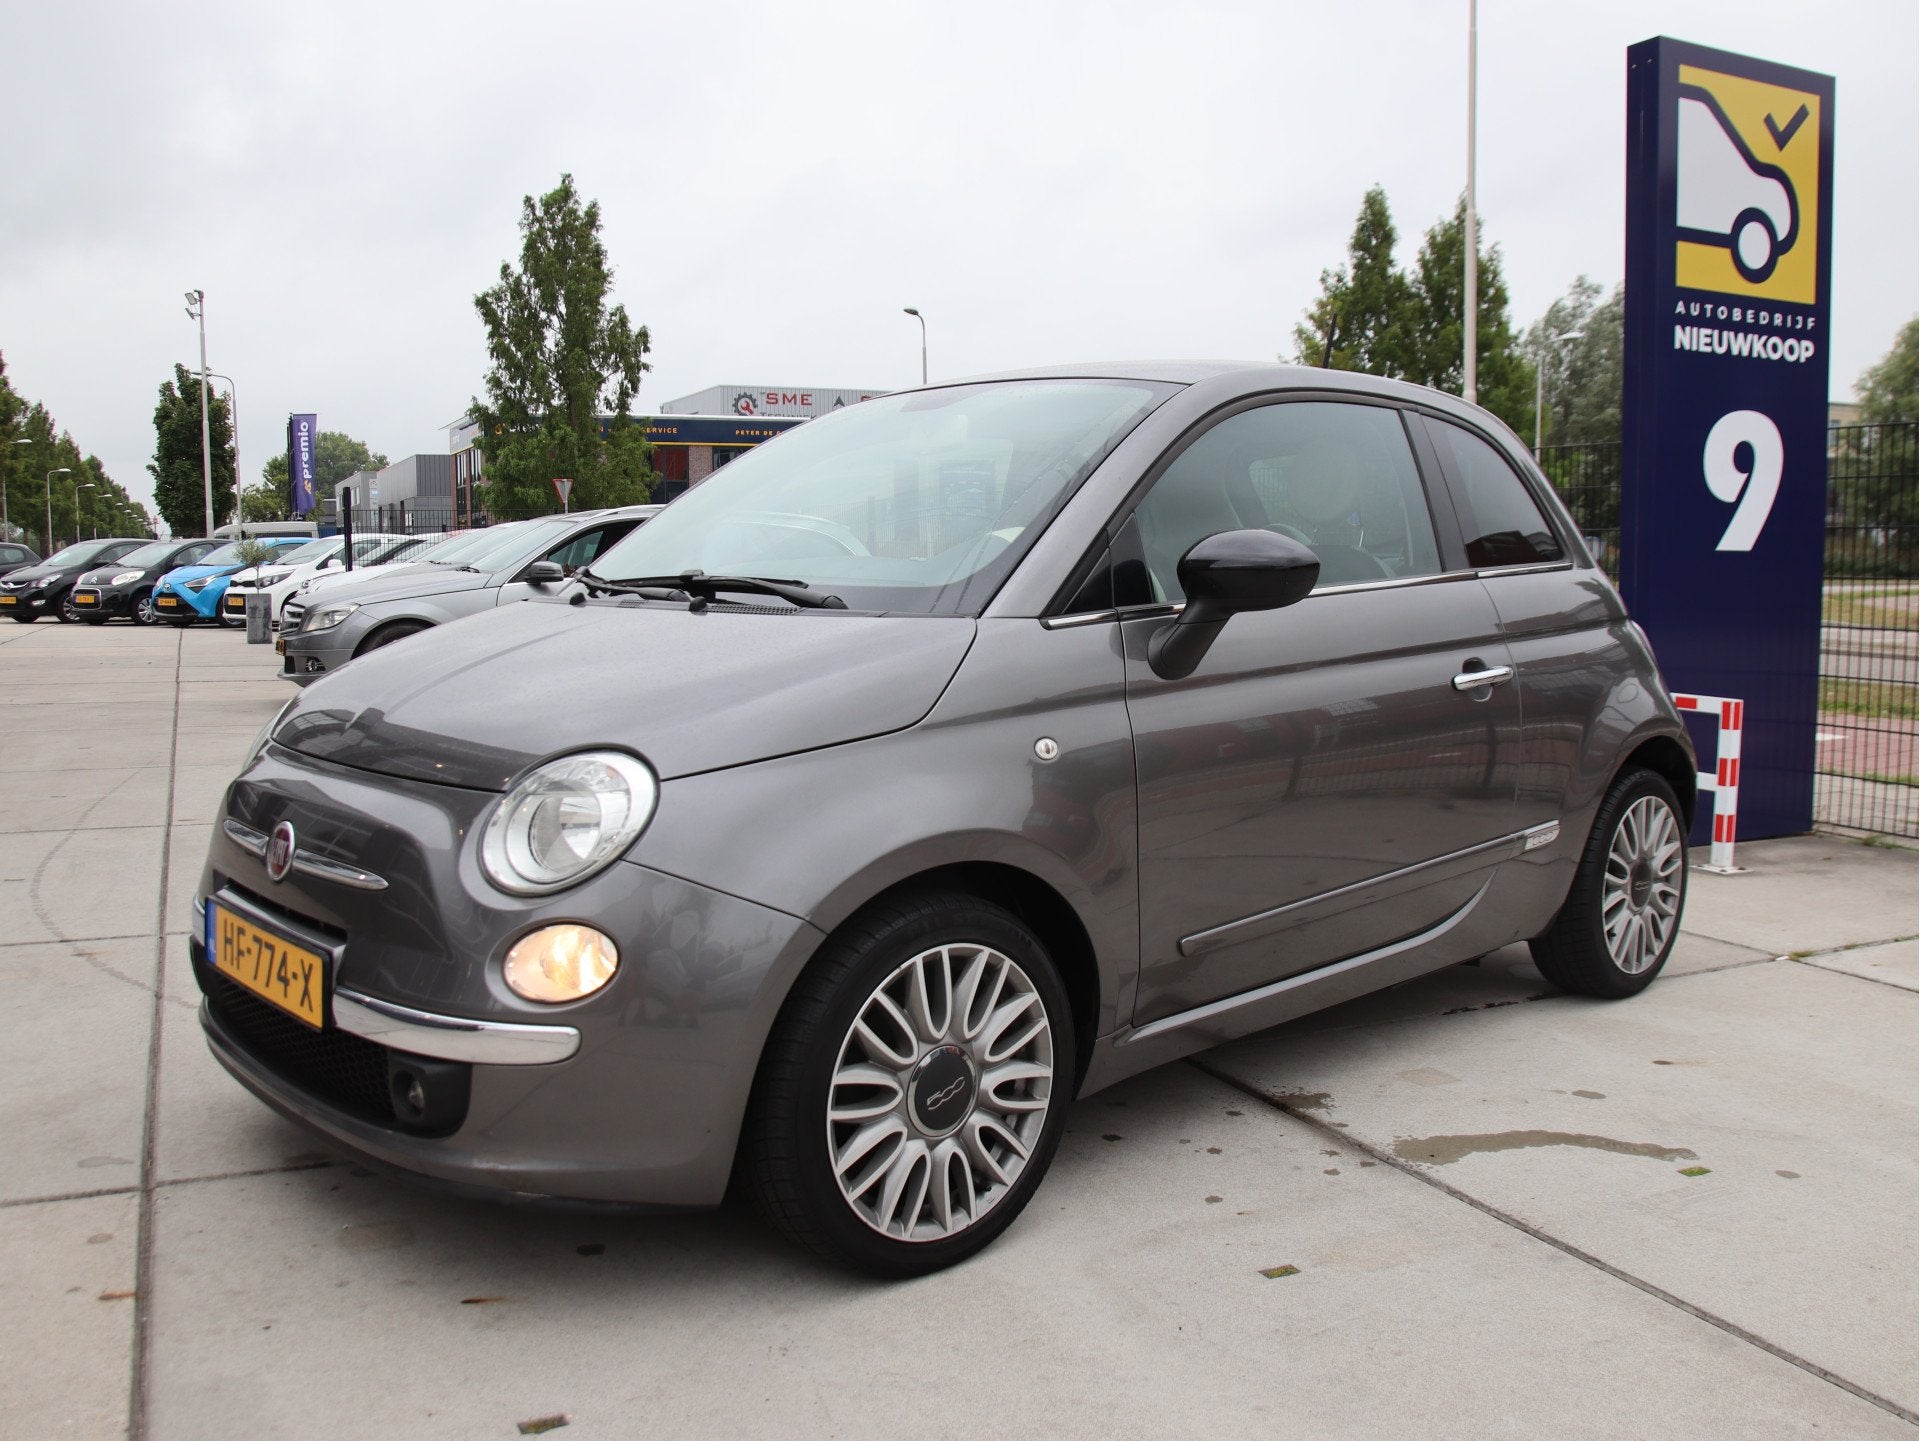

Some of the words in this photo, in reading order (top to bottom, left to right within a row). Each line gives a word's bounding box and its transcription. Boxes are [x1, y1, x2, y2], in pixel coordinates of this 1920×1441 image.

[1674, 300, 1816, 331] AUTOBEDRIJF
[1673, 324, 1815, 364] NIEUWKOOP
[766, 392, 813, 406] SME
[298, 421, 312, 479] premio
[1703, 409, 1784, 552] 9
[222, 917, 314, 1013] HF-774-X
